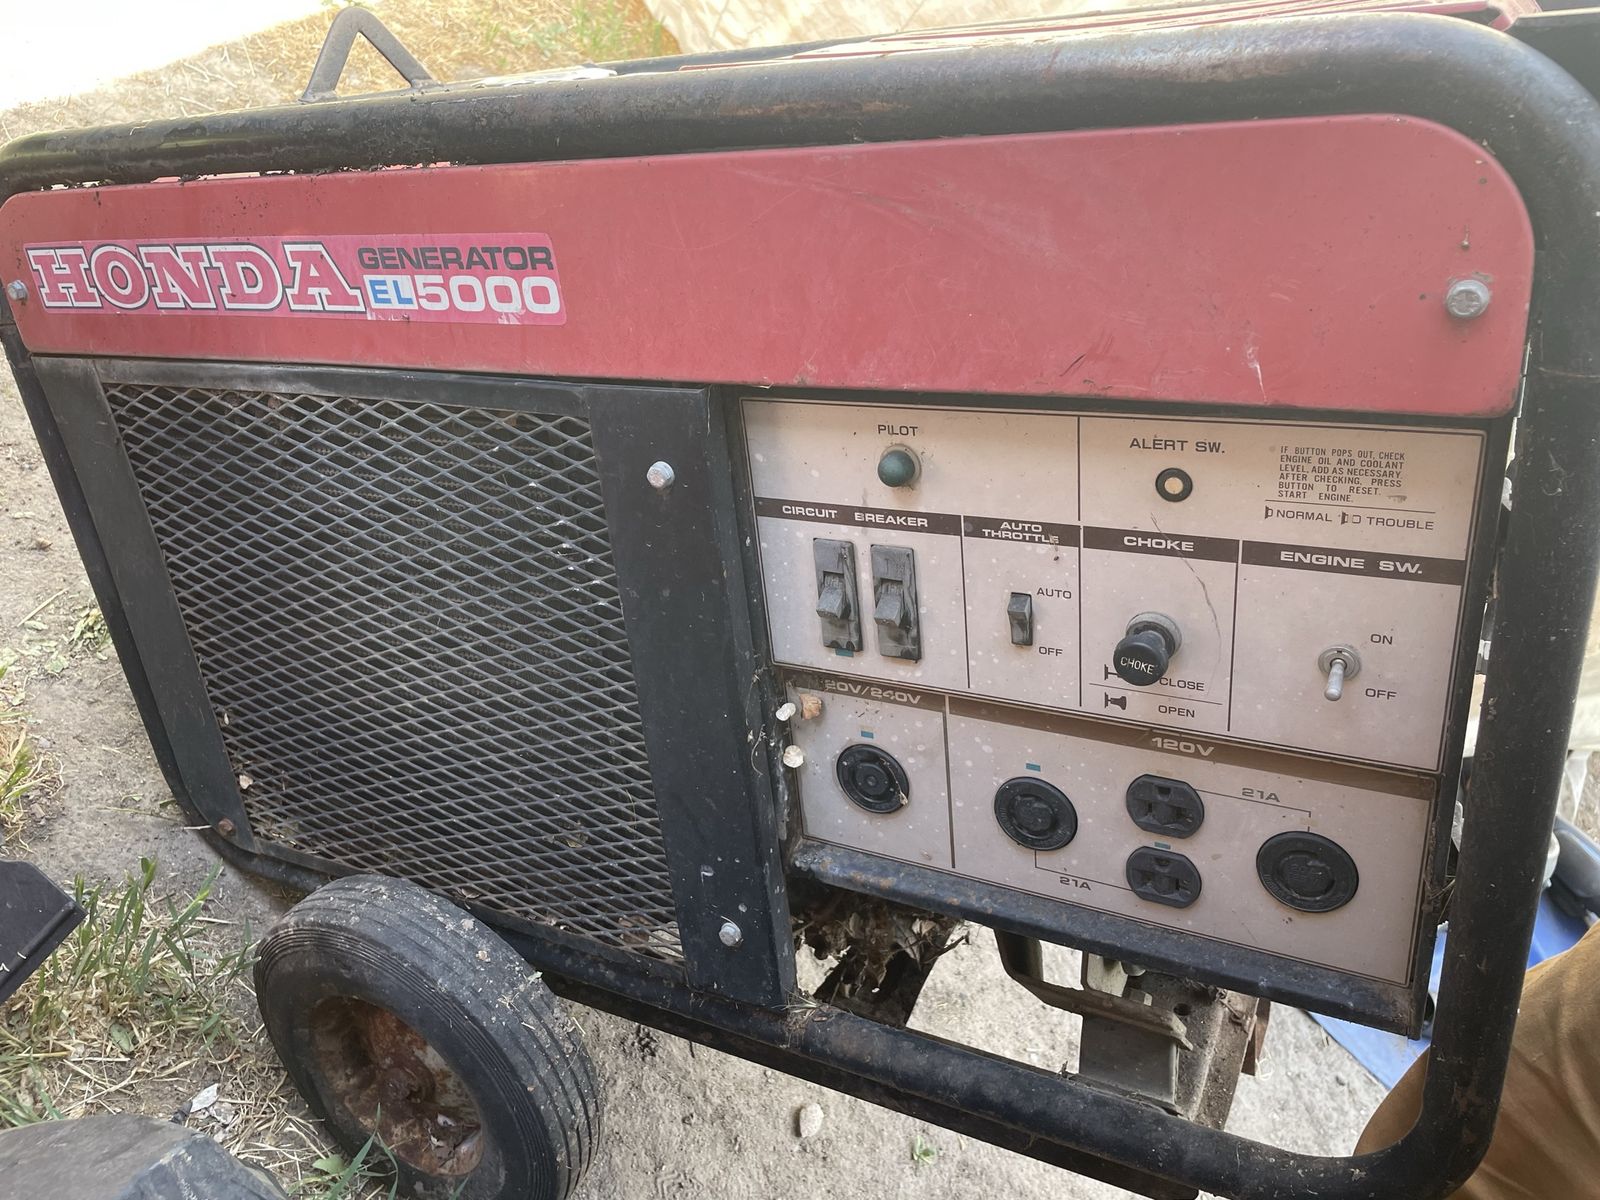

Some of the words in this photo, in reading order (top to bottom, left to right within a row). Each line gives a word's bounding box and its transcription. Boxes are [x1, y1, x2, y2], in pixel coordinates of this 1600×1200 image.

[357, 246, 554, 270] GENERATOR
[26, 242, 366, 311] HONDA
[878, 424, 918, 437] PILOT
[1129, 437, 1189, 451] ALERT
[1195, 441, 1225, 454] SW.
[1281, 446, 1288, 455] IF
[1295, 446, 1326, 456] BUTTON
[1331, 449, 1352, 458] POPS
[1357, 450, 1376, 460] OUT,
[1379, 451, 1405, 461] CHECK
[1280, 455, 1312, 464] ENGINE
[1318, 456, 1331, 466] OIL
[1337, 458, 1355, 467] AND
[1360, 459, 1404, 469] COOLANT
[1311, 465, 1330, 475] ADD
[1331, 467, 1344, 476] AS
[1279, 472, 1308, 482] AFTER
[1371, 478, 1402, 488] PRESS
[1278, 481, 1314, 491] BUTTON
[1326, 484, 1337, 493] TO
[1349, 485, 1382, 496] RESET.
[1278, 490, 1307, 500] START
[1318, 492, 1354, 503] ENGINE.
[782, 505, 838, 519] CIRCUIT
[854, 512, 928, 528] BREAKER
[1276, 509, 1333, 522] NORMAL
[1000, 521, 1043, 532] AUTO
[1366, 516, 1435, 531] TROUBLE
[982, 529, 1060, 544] THROTTLE
[1123, 536, 1195, 552] CHOKE
[1280, 551, 1365, 570] ENGINE
[1379, 559, 1424, 575] SW.
[1036, 587, 1072, 600] AUTO
[1370, 633, 1393, 645] ON
[1038, 646, 1063, 657] OFF
[1120, 656, 1155, 675] CHOKE
[1159, 677, 1205, 692] CLOSE
[1364, 687, 1397, 700] OFF
[1158, 705, 1195, 718] OPEN
[1152, 737, 1215, 757] 120V
[1241, 787, 1281, 803] 21A
[1059, 876, 1092, 891] 21A
